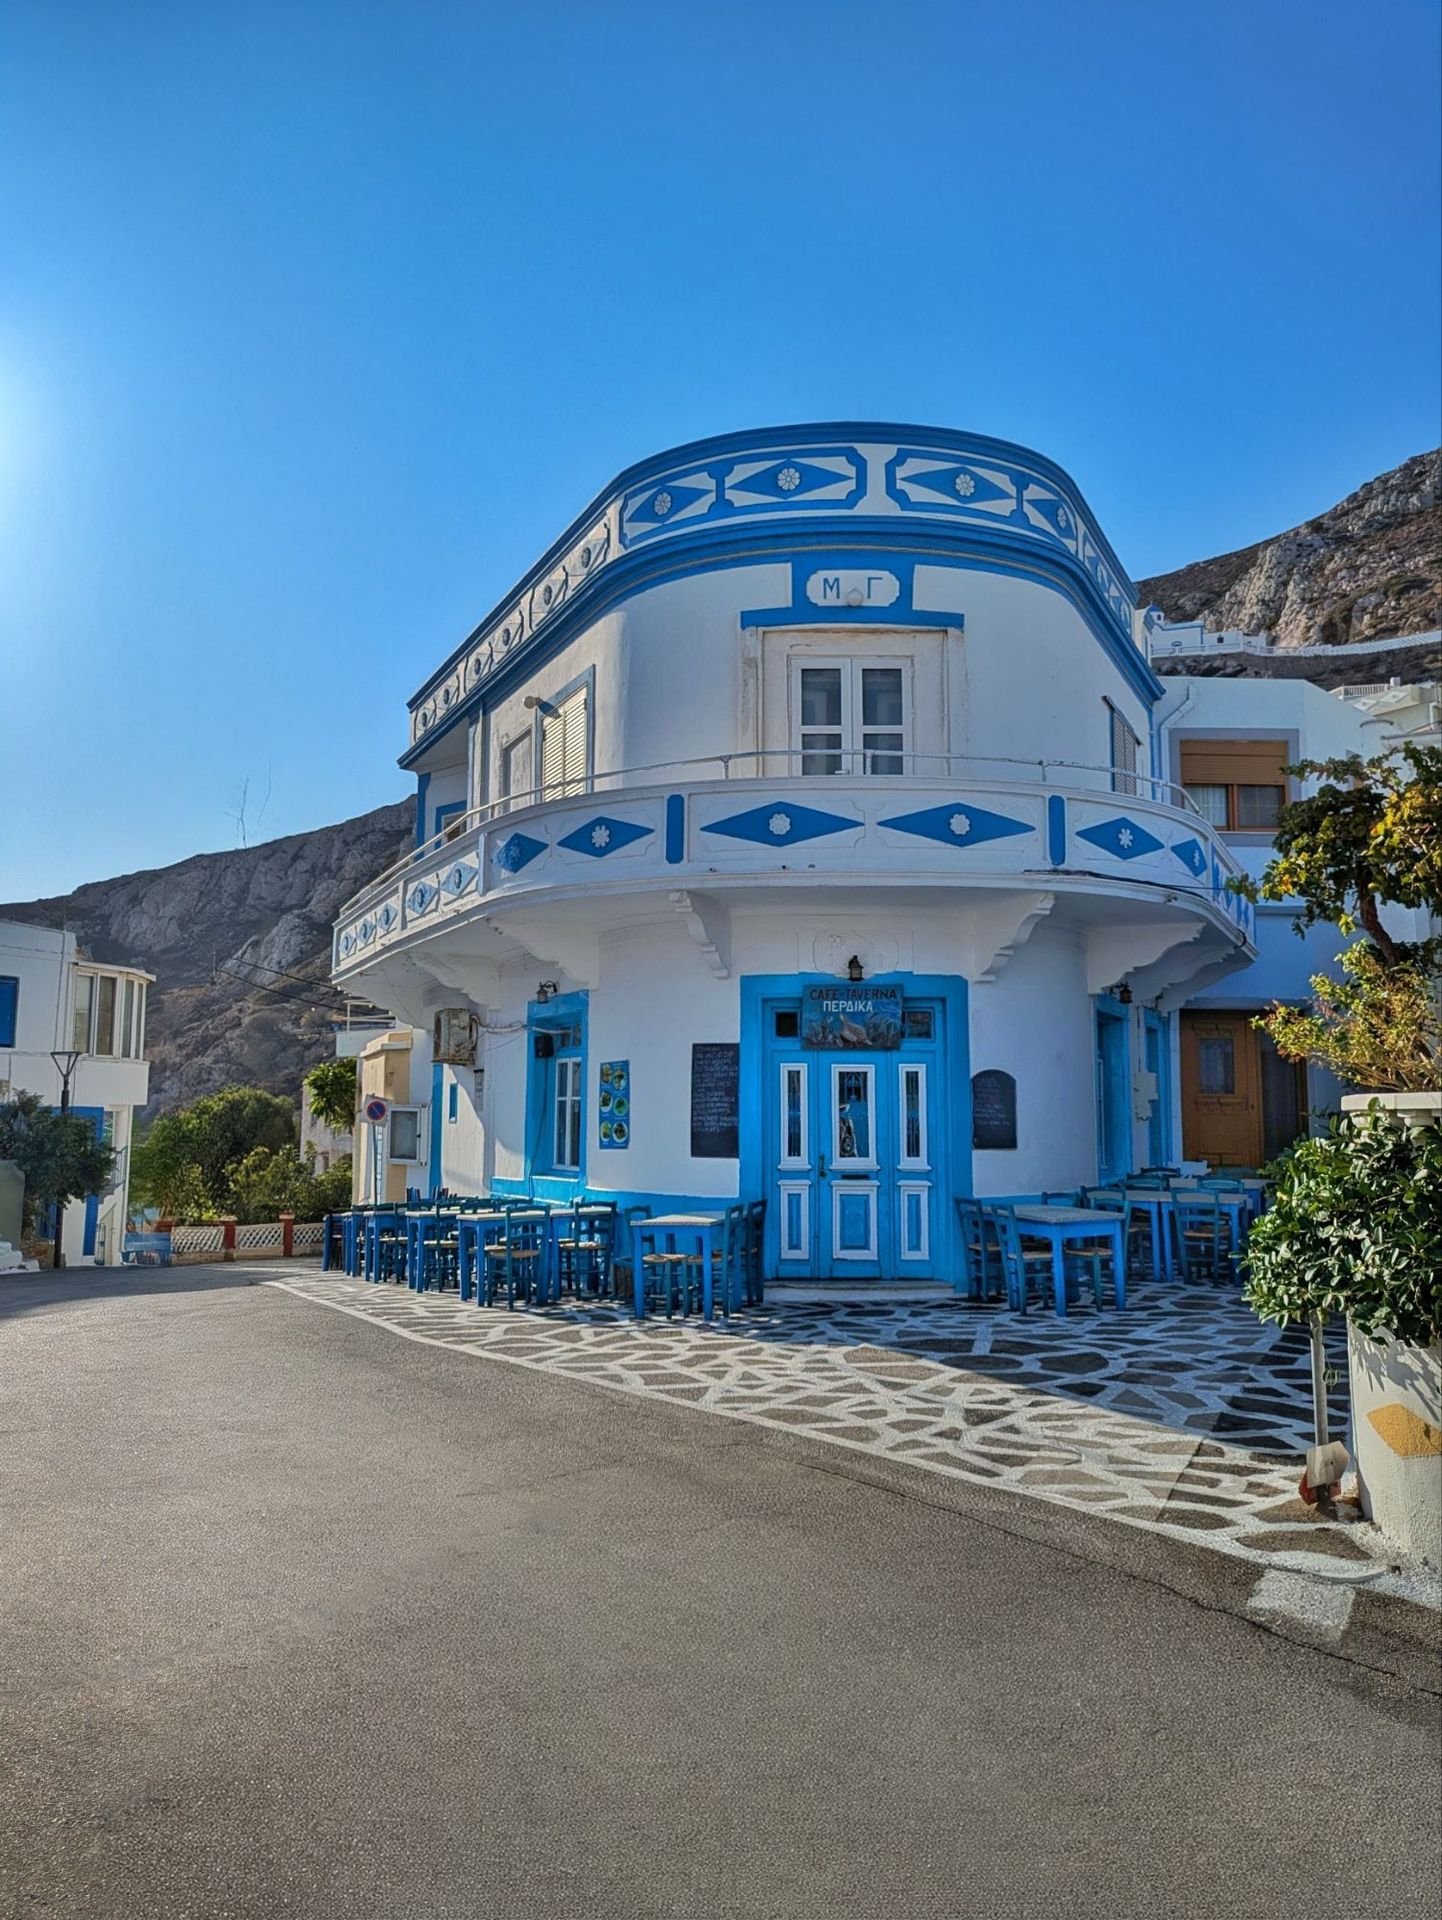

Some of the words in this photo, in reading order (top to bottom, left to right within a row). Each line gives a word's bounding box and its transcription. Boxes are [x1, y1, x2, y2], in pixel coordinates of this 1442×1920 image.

[867, 577, 883, 599] Γ
[809, 988, 839, 1000] CAFE
[846, 988, 897, 999] TAVERNA
[823, 1001, 873, 1012] ΠΕΡΔΙΚΑ
